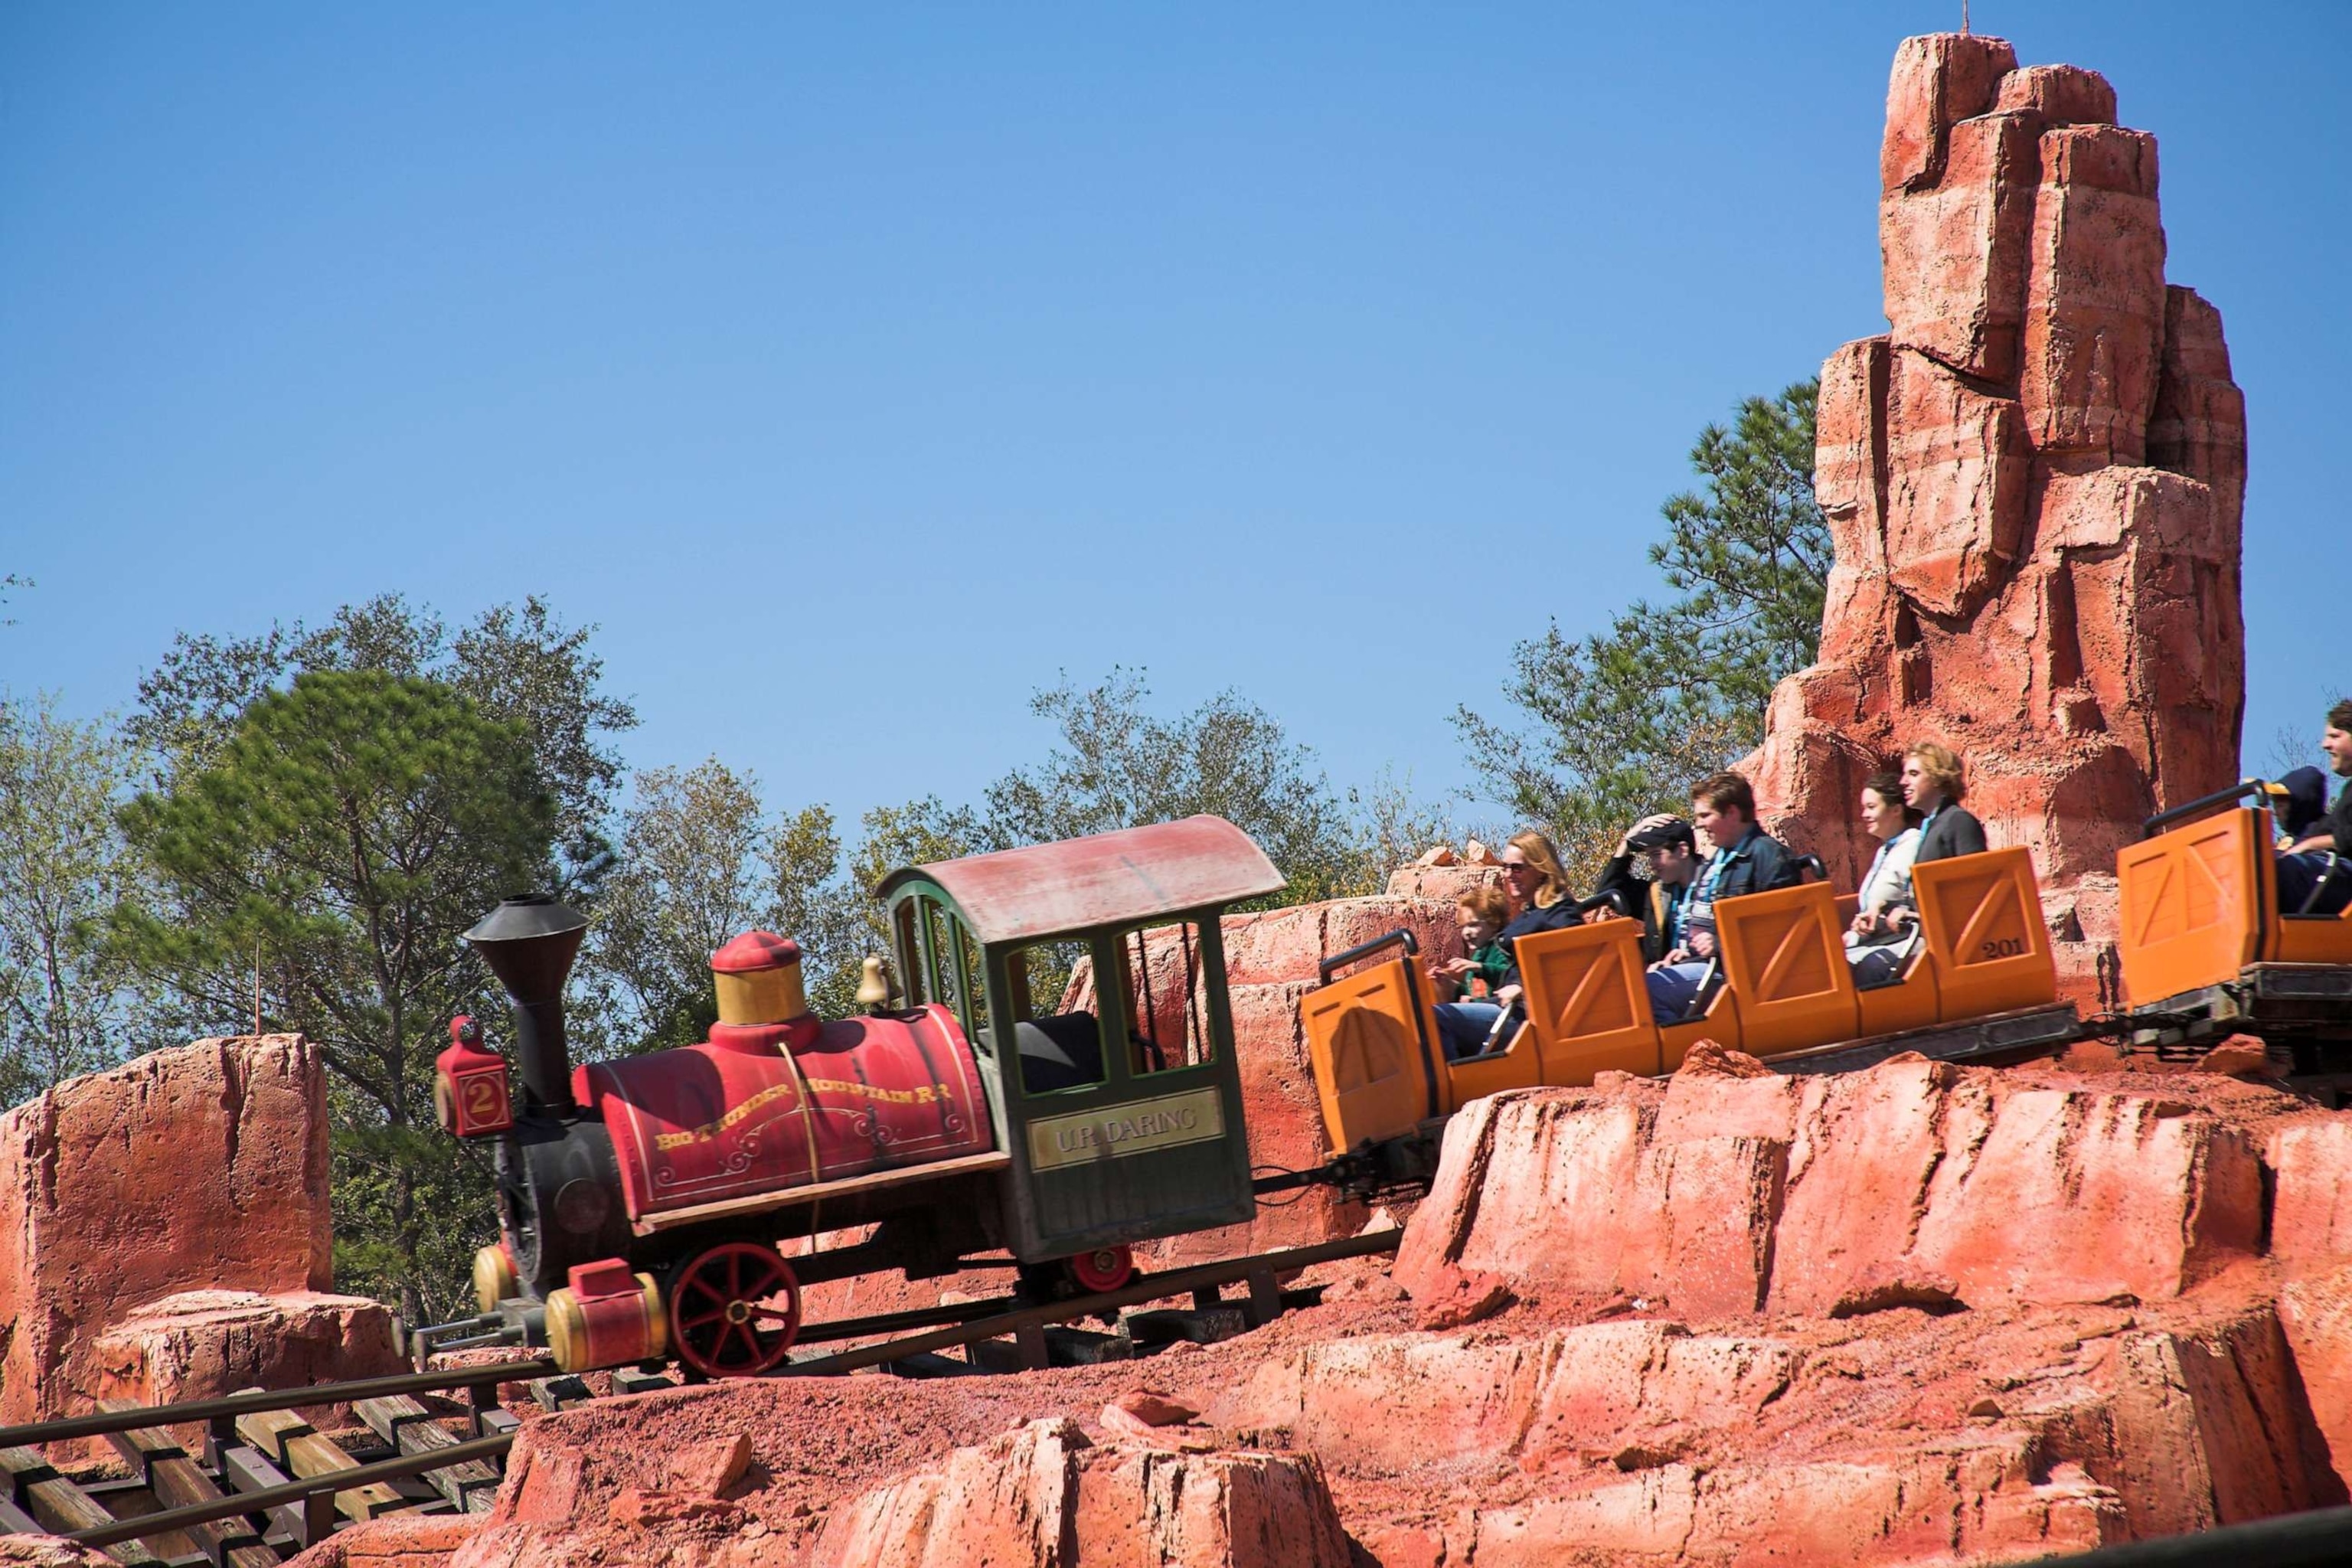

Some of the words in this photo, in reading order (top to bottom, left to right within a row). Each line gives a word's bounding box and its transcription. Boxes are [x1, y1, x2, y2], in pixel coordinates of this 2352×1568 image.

[1983, 938, 2024, 959] 201
[468, 1083, 495, 1113] 2
[1105, 1108, 1197, 1143] DARING
